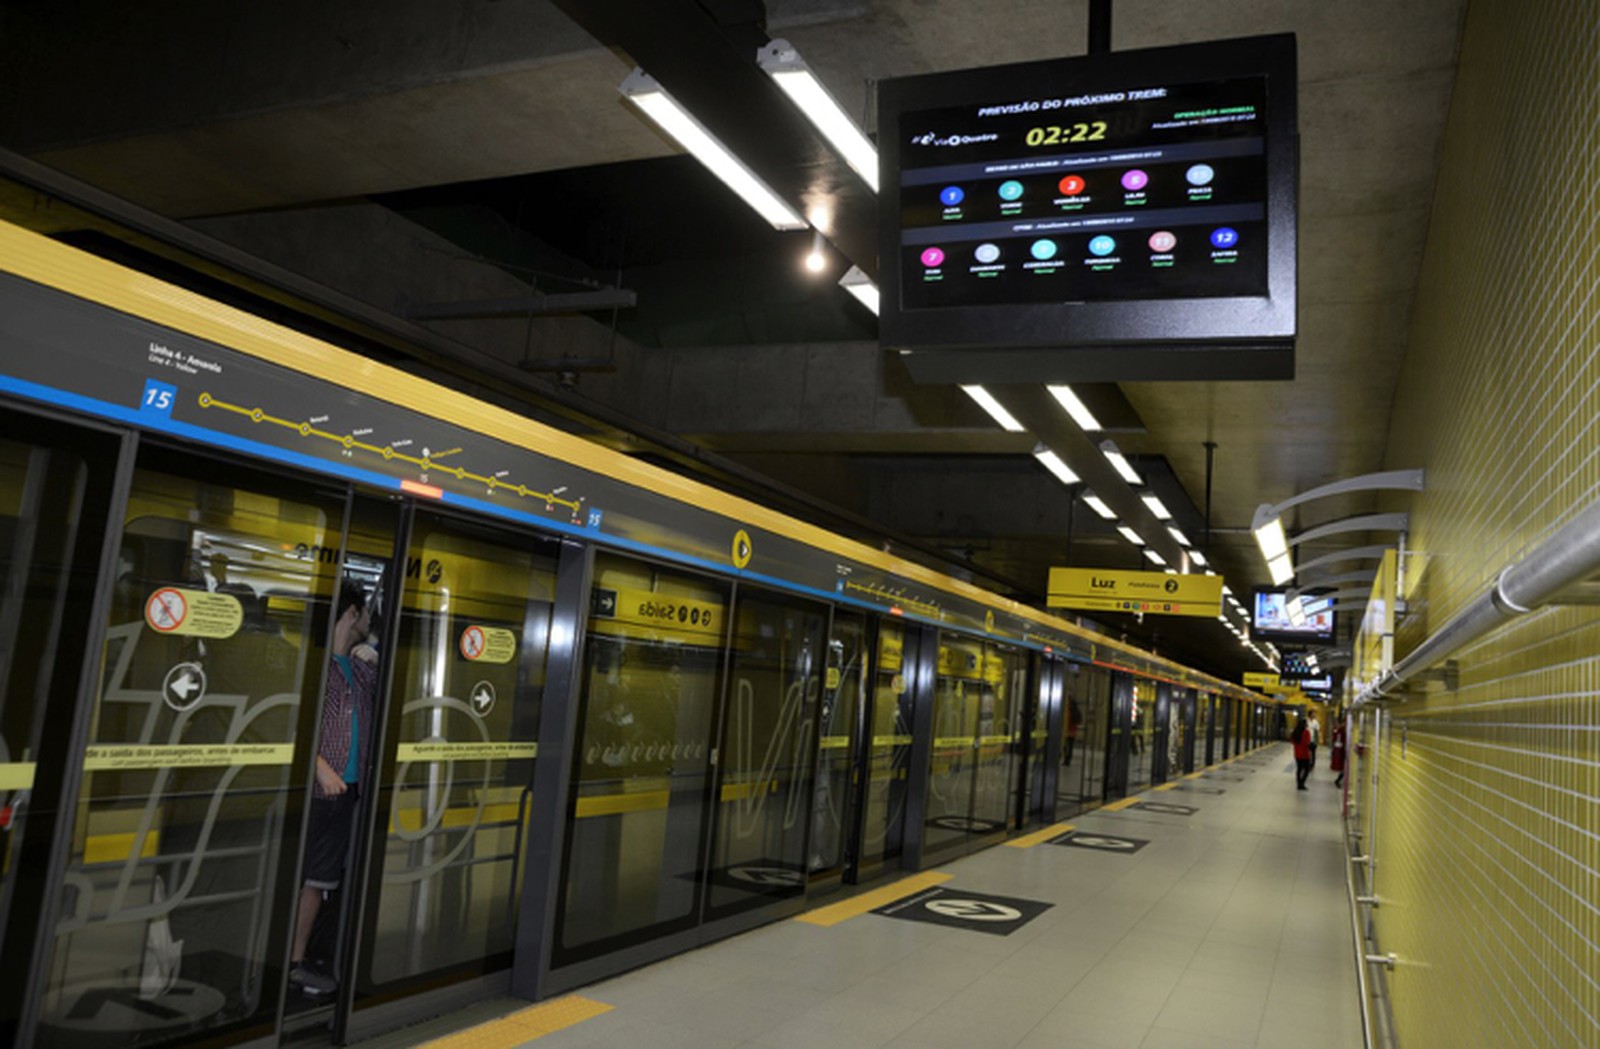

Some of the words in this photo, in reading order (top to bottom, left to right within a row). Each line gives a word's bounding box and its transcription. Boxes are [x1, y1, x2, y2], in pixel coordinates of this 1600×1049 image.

[978, 101, 1039, 117] PREVISÃO
[1042, 99, 1061, 110] DO
[1064, 92, 1125, 107] PRÓXIMO
[1026, 121, 1107, 146] 02:22
[149, 342, 173, 358] Linha
[146, 388, 172, 409] 15
[1091, 576, 1116, 588] Luz
